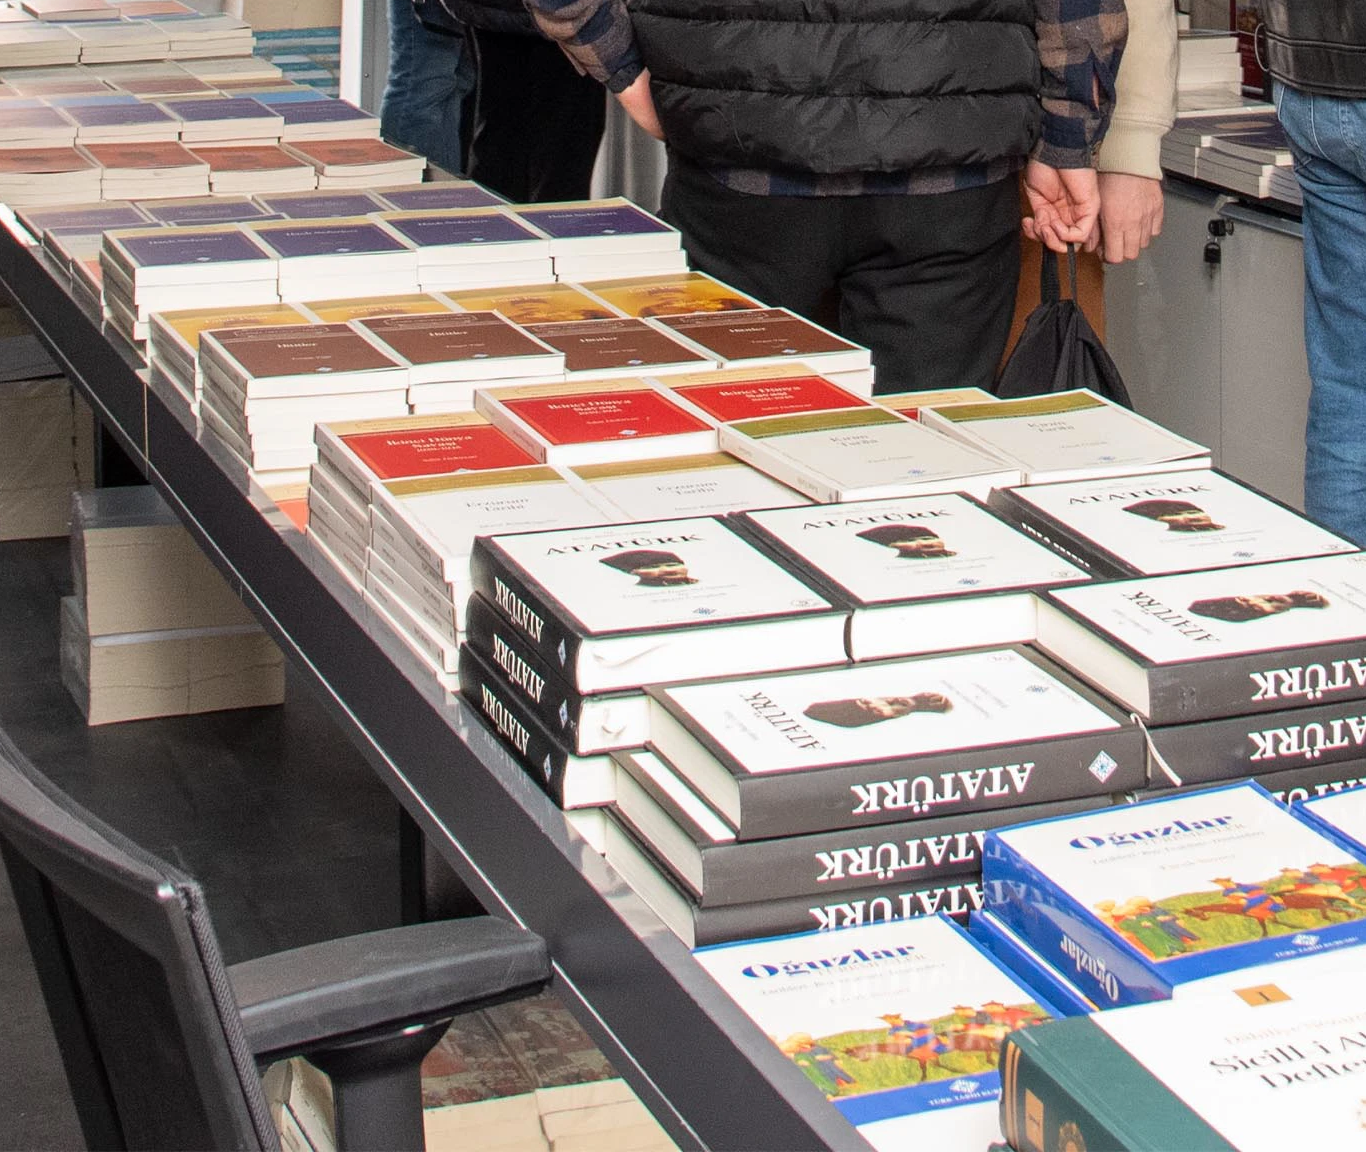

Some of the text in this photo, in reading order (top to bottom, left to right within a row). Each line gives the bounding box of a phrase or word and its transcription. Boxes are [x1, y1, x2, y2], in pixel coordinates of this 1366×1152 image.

[803, 509, 955, 530] ATATÜRK
[1068, 483, 1213, 506] ATATÜRK
[547, 534, 706, 556] ATATÜRK
[494, 576, 545, 644] ATATÜRK
[1123, 591, 1221, 642] ATATÜRK
[493, 633, 545, 704] ATATÜRK
[481, 683, 531, 756] ATATÜRK
[738, 691, 828, 751] ATATÜRK
[850, 761, 1036, 816] ATATÜRK
[1069, 816, 1233, 849] Oğuzlar
[742, 945, 915, 978] Oğuzlar
[1060, 934, 1119, 1002] Oğuzlar
